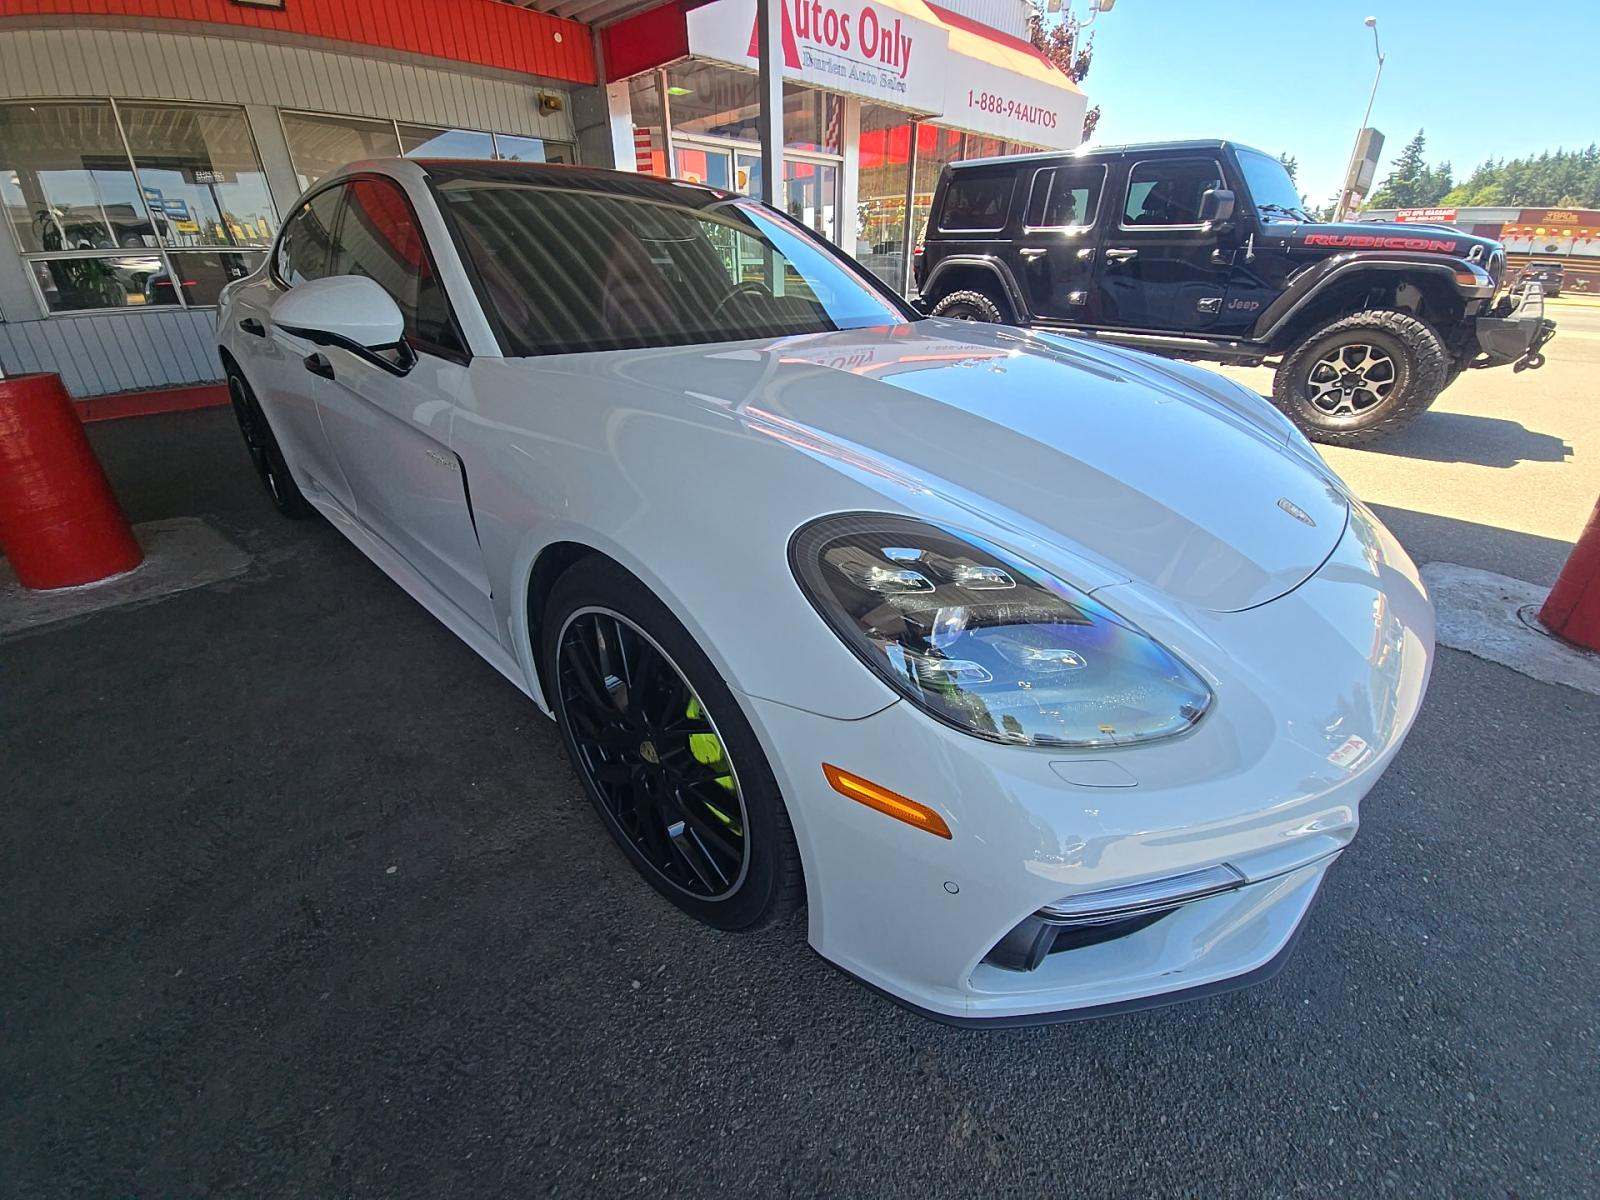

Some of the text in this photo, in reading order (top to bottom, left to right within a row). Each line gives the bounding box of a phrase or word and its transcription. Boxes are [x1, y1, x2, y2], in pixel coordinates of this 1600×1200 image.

[747, 0, 913, 79] Autos Only
[803, 51, 907, 93] Burien Auto Sales
[968, 89, 1057, 129] 1-888-94AUTOS
[1304, 234, 1457, 252] RUBICON
[1228, 299, 1260, 312] Jeep
